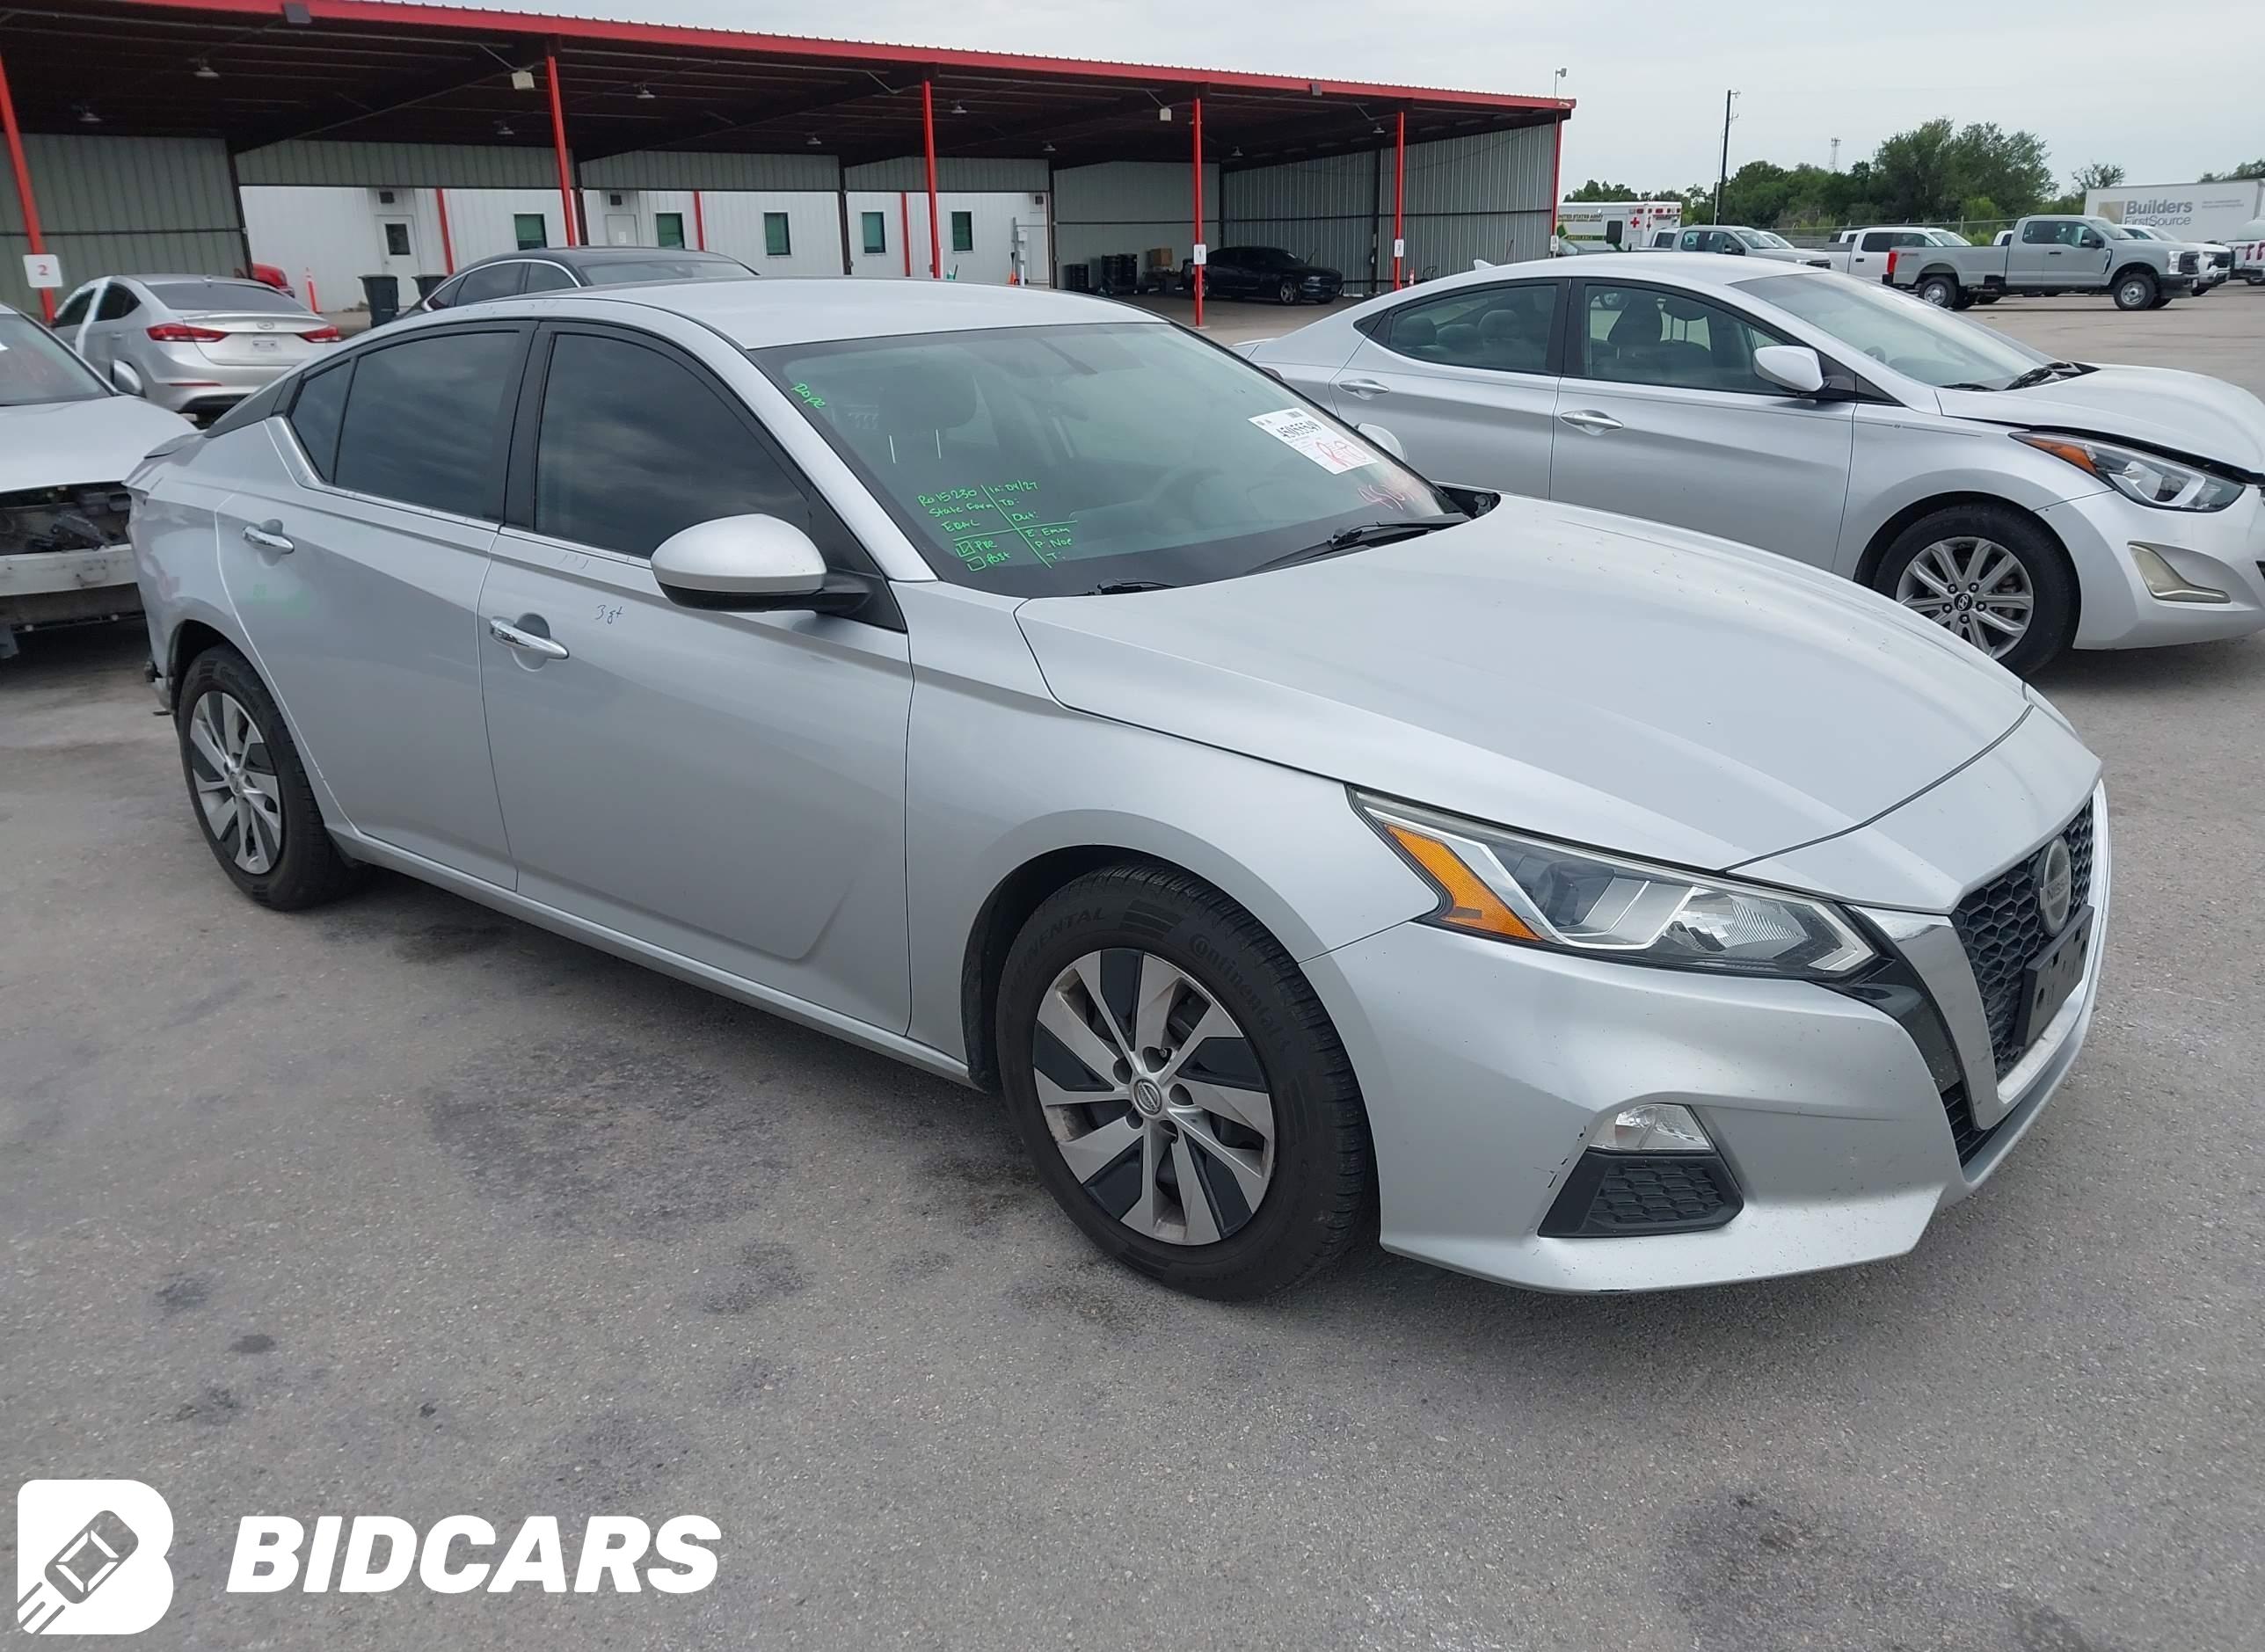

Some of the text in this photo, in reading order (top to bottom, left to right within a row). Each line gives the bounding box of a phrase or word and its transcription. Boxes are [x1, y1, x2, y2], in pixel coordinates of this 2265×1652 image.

[2126, 199, 2193, 215] Builders
[2123, 215, 2192, 227] FirstSource
[37, 265, 49, 276] 2
